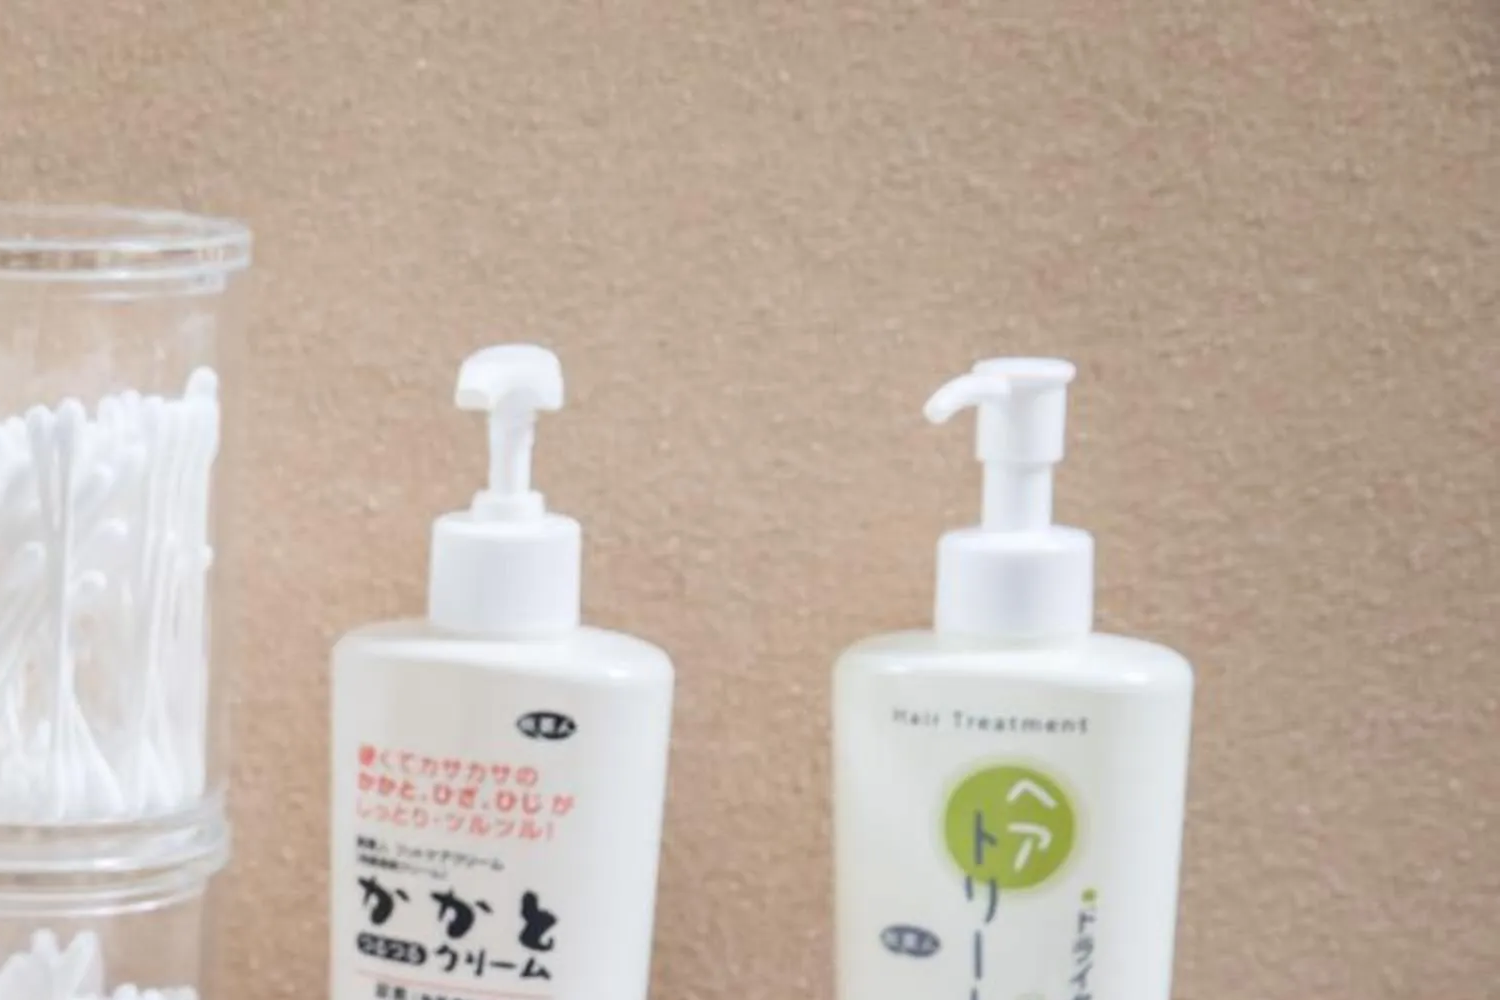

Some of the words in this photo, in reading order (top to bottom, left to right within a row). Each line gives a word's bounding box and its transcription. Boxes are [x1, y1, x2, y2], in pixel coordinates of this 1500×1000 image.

[952, 709, 1089, 735] Treatment
[1006, 778, 1058, 873] ヘア
[357, 874, 559, 953] かかと
[433, 944, 552, 981] クリーム
